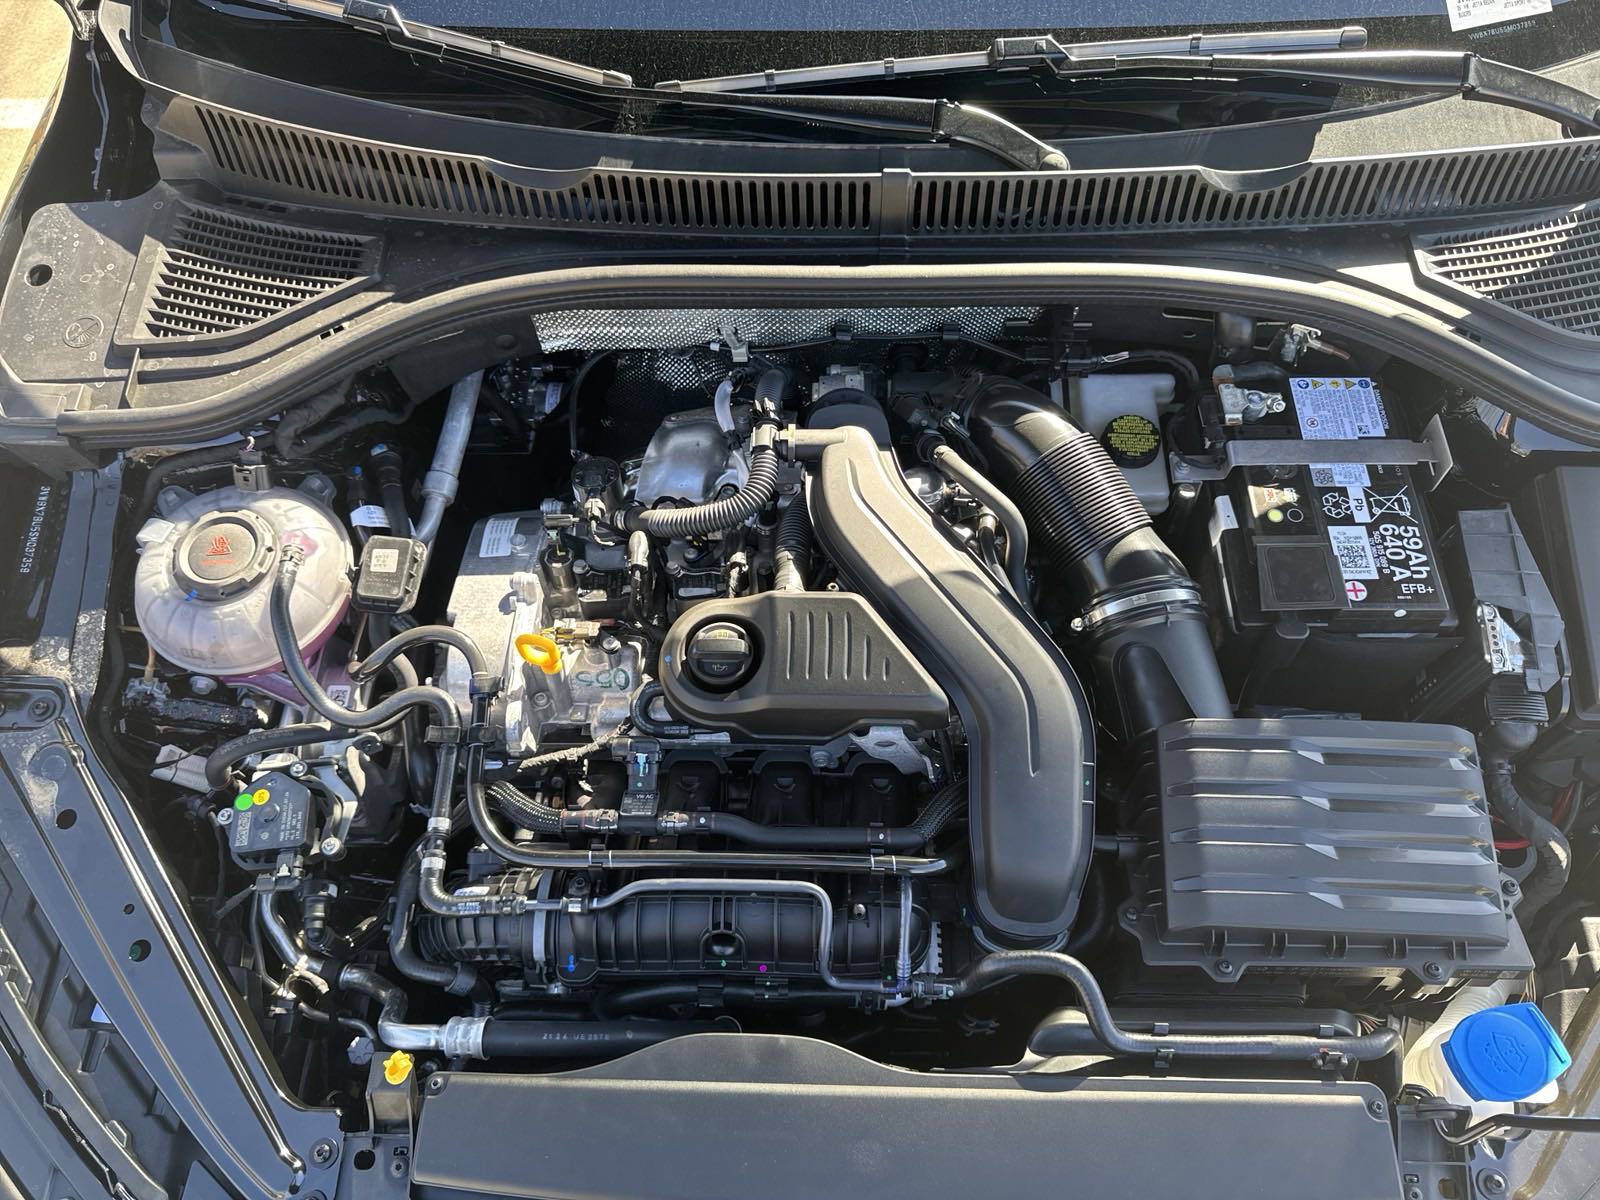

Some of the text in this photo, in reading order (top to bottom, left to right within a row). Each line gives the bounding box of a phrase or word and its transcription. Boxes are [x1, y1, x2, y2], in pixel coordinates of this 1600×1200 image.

[1353, 498, 1364, 511] Pb
[1379, 523, 1407, 561] 640
[1400, 525, 1431, 579] 59Ah
[1389, 565, 1412, 582] A
[1401, 583, 1435, 594] EFB+
